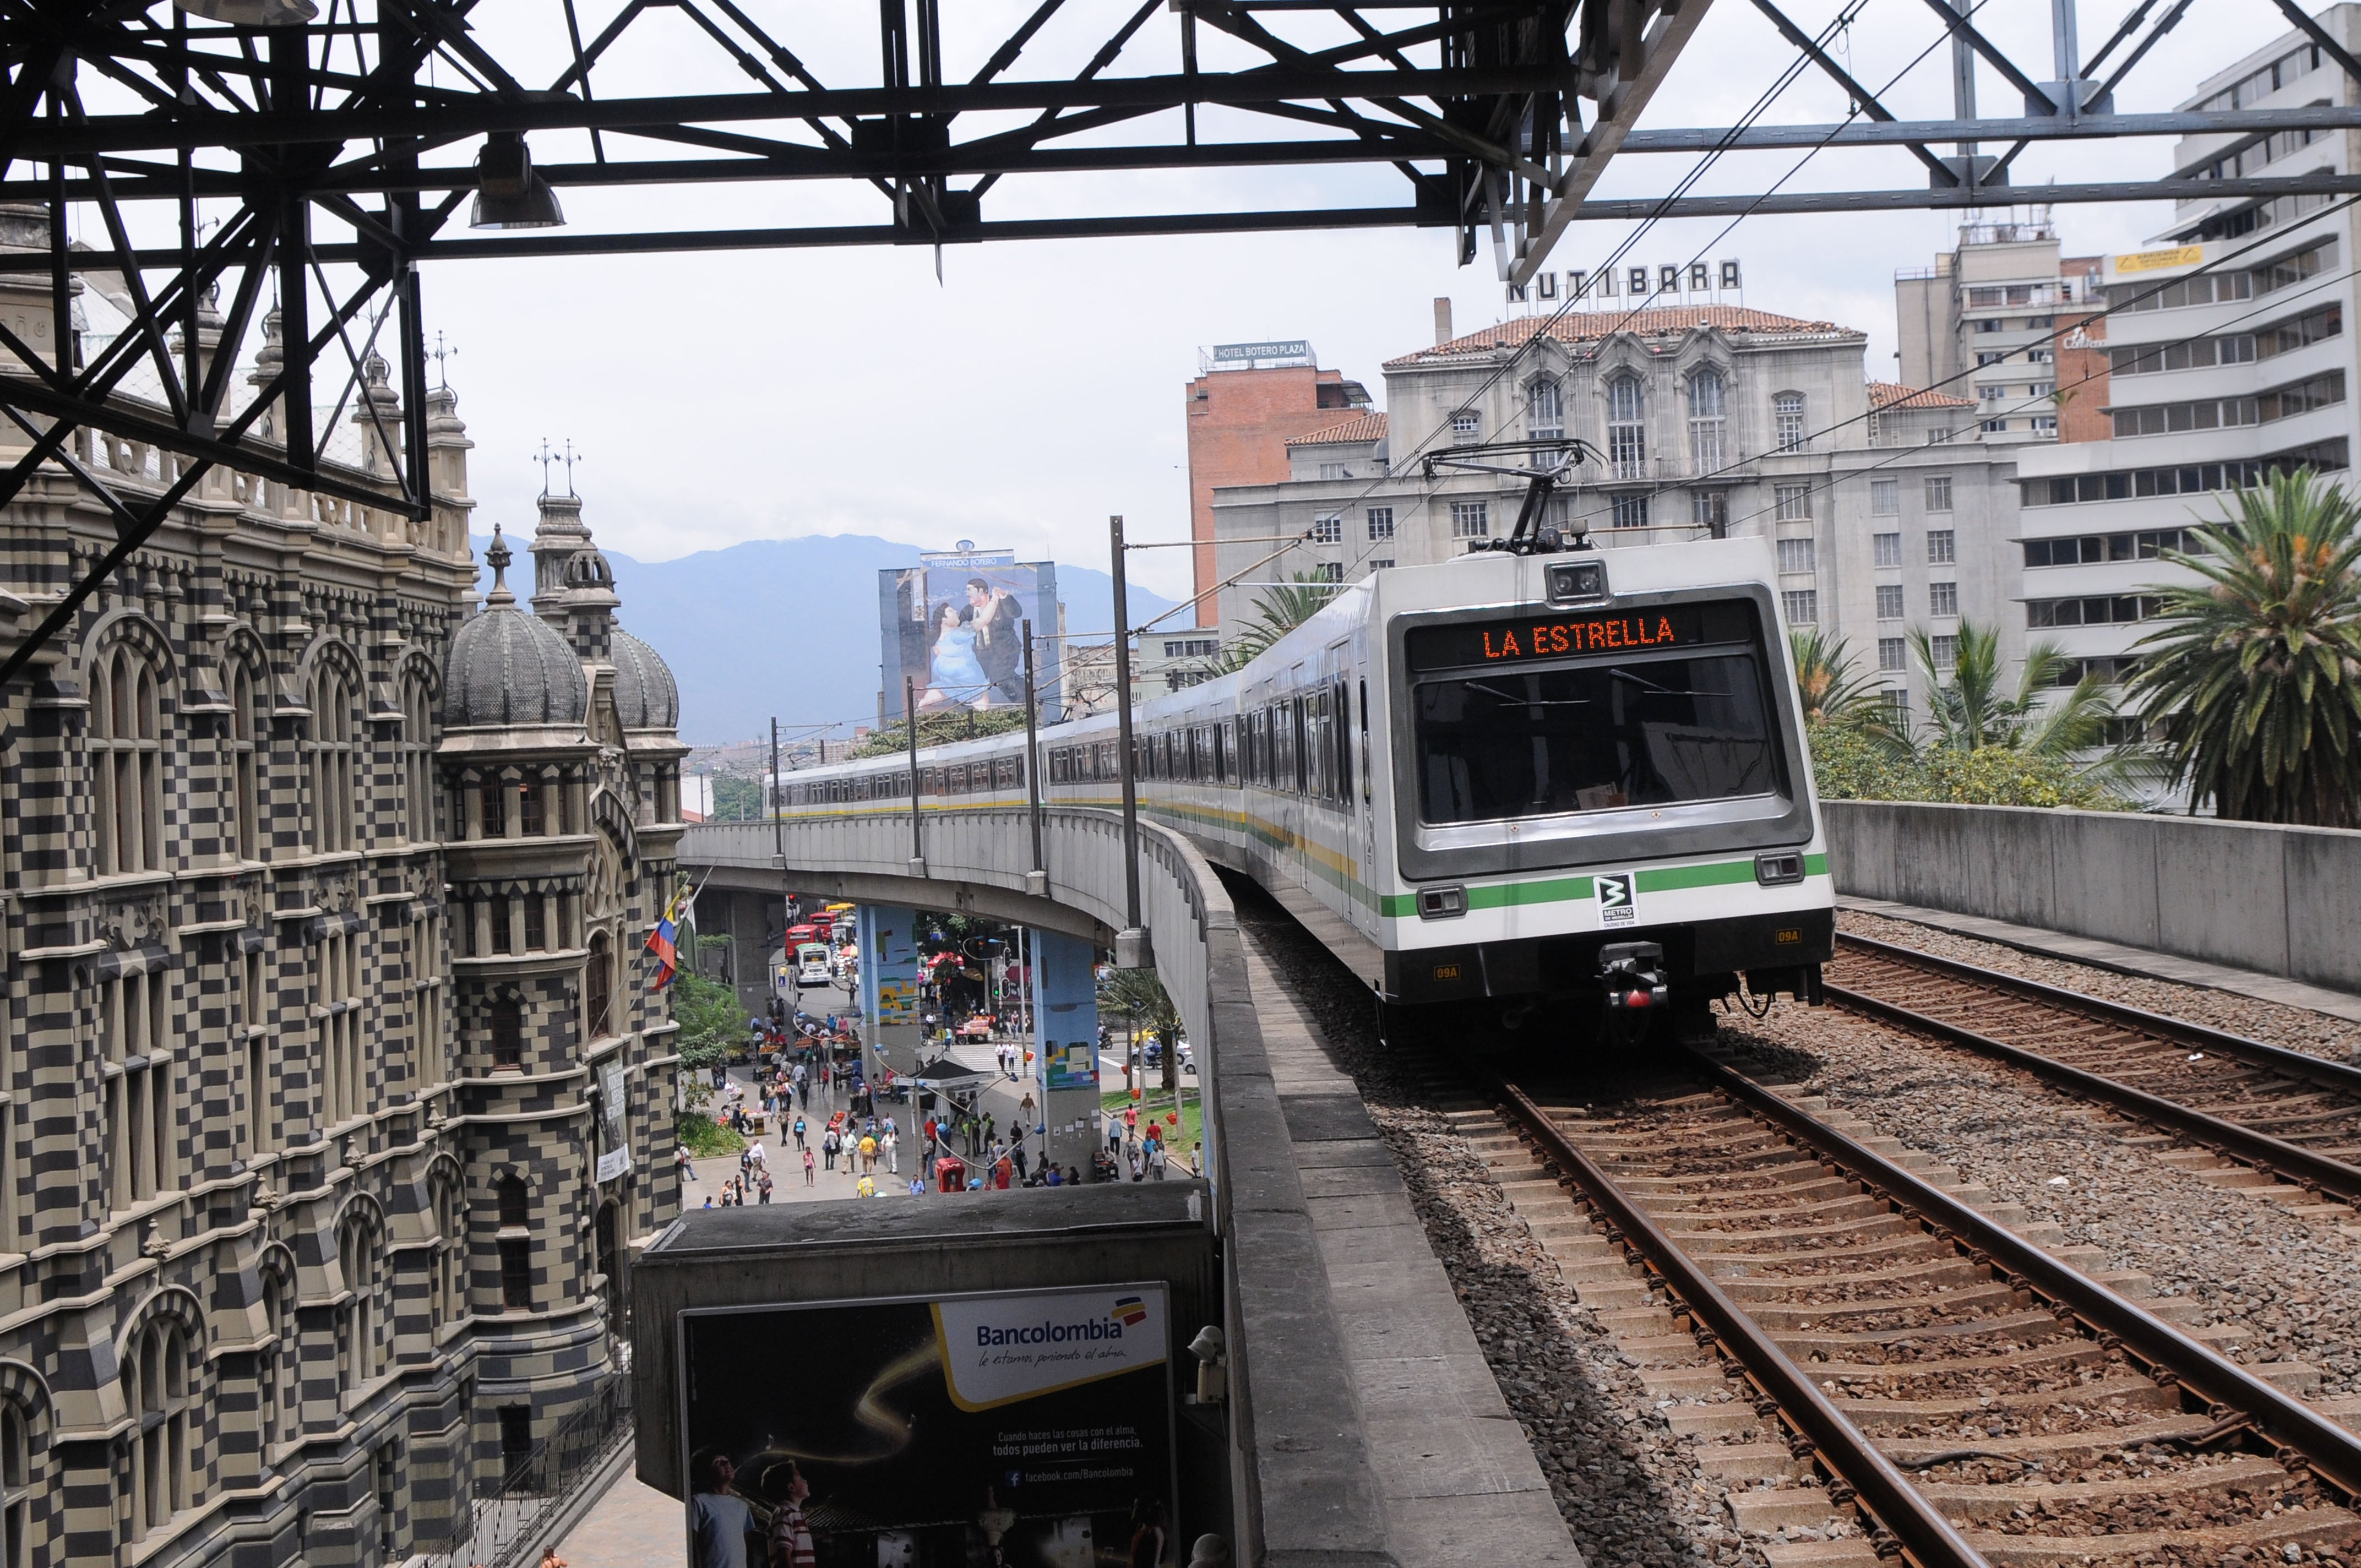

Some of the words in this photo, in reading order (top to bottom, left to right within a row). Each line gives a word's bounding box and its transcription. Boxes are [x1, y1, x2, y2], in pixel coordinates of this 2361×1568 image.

[1509, 262, 1739, 301] NUTIBARA
[1218, 348, 1243, 358] HOTEL
[1245, 346, 1277, 356] BOTERO
[1280, 344, 1305, 355] PLAZA
[931, 559, 969, 567] FERNANDO
[970, 557, 997, 565] BOTERO
[1483, 630, 1520, 657] LA
[1533, 616, 1674, 654] ESTRELLA
[1604, 908, 1631, 916] METRO
[1778, 930, 1798, 942] 09A
[1438, 967, 1457, 978] 09A
[977, 1317, 1123, 1346] Bancolombia
[978, 1350, 989, 1367] le
[993, 1350, 1033, 1365] estamos
[1034, 1348, 1081, 1367] poniendo
[1085, 1347, 1097, 1360] el
[1098, 1346, 1128, 1358] alma
[998, 1431, 1027, 1442] Cuando
[1028, 1430, 1051, 1441] haces
[1053, 1429, 1065, 1439] las
[1066, 1428, 1089, 1438] cosas
[1090, 1427, 1104, 1437] con
[1106, 1425, 1114, 1435] el
[1115, 1424, 1137, 1435] alma,
[993, 1444, 1020, 1456] todos
[1022, 1442, 1058, 1457] pueden
[1060, 1441, 1076, 1452] ver
[1079, 1439, 1089, 1451] la
[1091, 1436, 1144, 1450] diferencia.
[1025, 1467, 1134, 1483] facebook.com/Bancolombia
